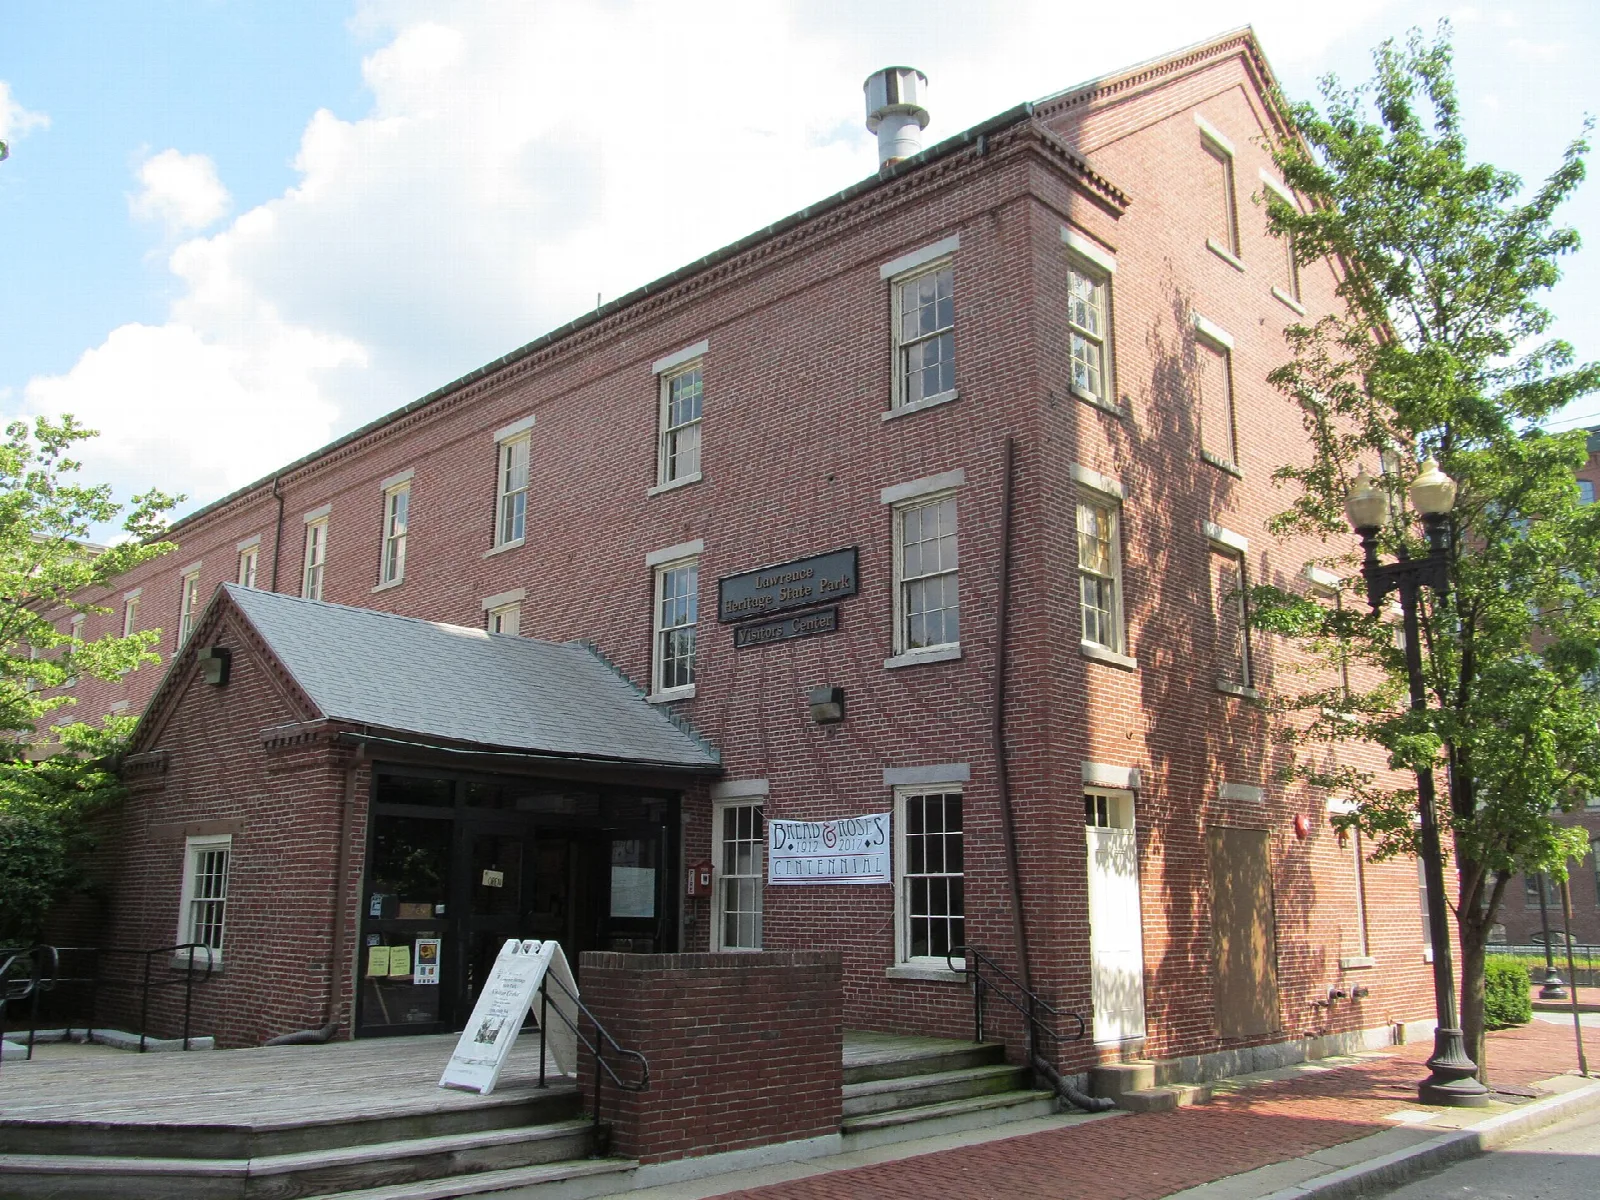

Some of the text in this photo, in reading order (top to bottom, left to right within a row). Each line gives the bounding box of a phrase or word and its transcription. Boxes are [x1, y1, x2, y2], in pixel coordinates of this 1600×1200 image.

[755, 567, 813, 589] Lawrence
[724, 574, 849, 614] Heritage State Park
[738, 615, 832, 643] Visitors Center
[773, 817, 885, 849] BREAD & ROSES
[796, 839, 862, 853] 1912 2012
[774, 858, 882, 875] CENTENNIAL
